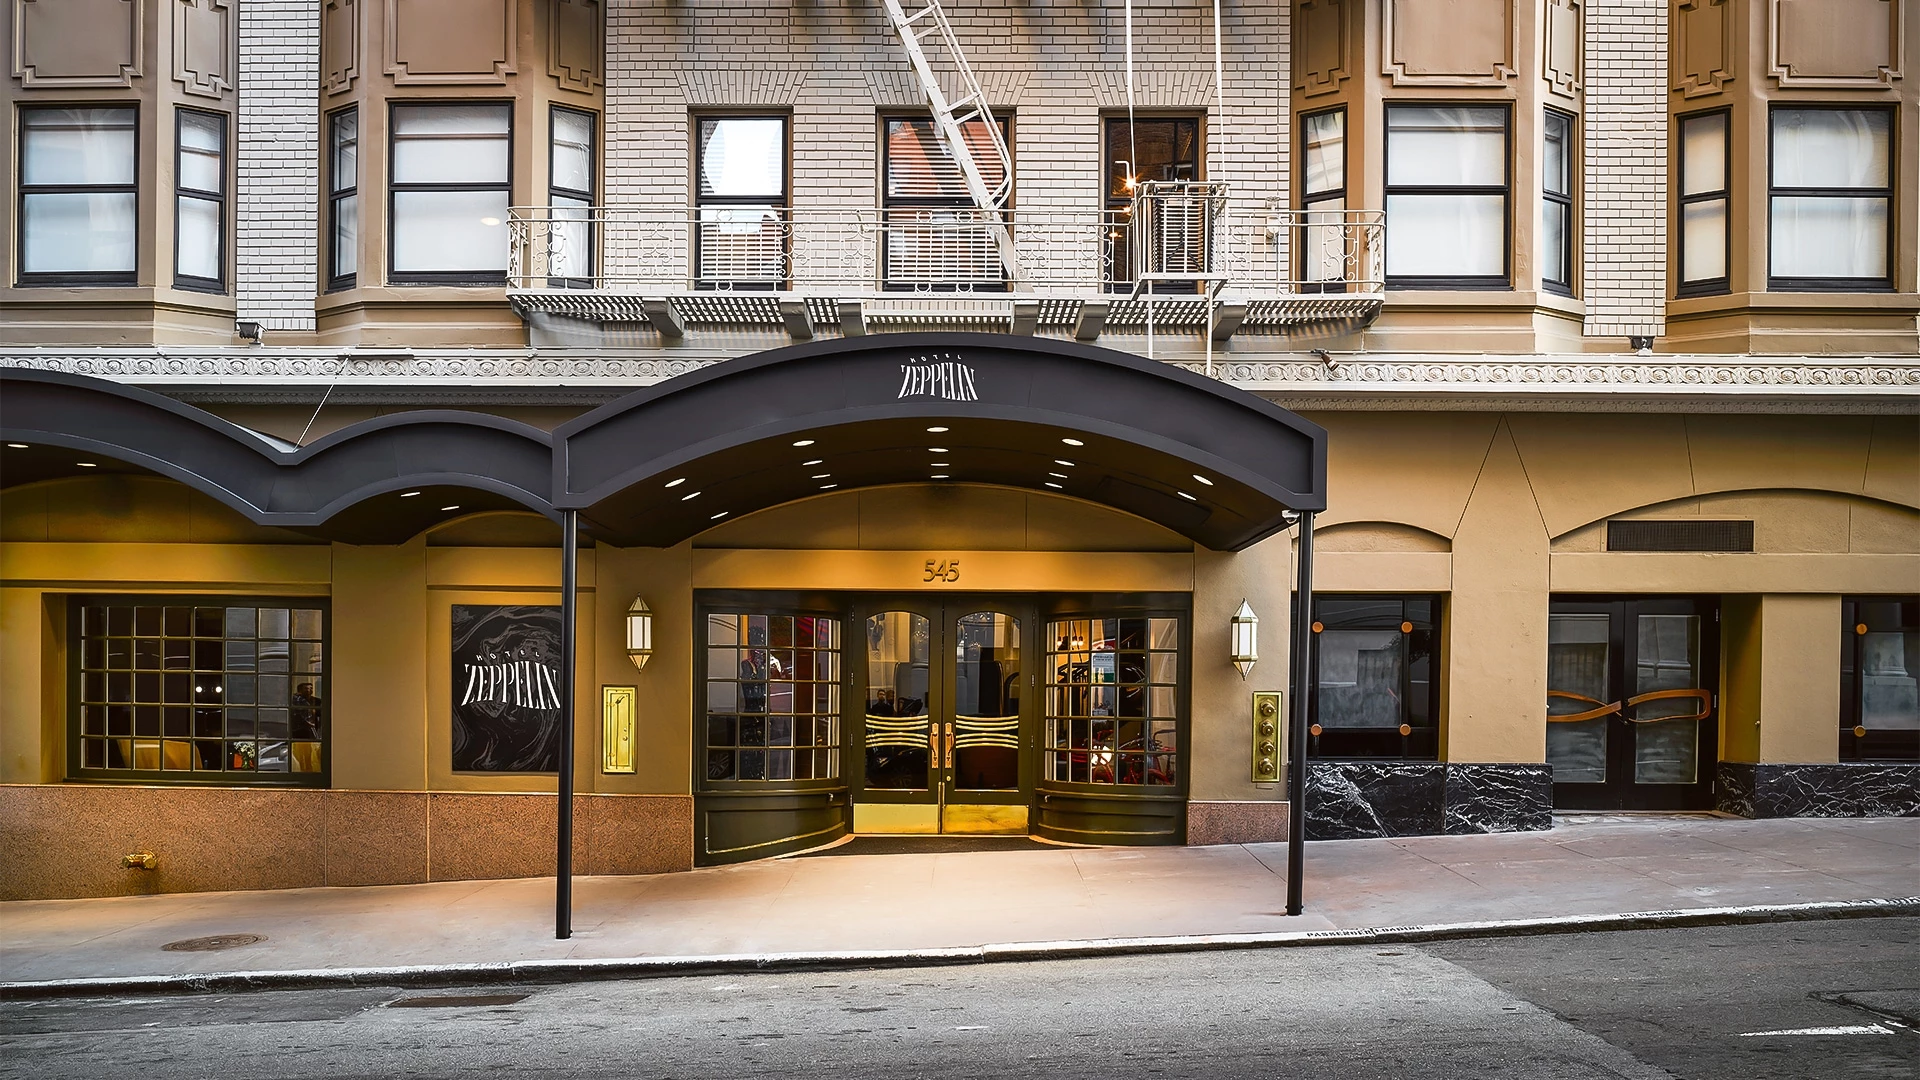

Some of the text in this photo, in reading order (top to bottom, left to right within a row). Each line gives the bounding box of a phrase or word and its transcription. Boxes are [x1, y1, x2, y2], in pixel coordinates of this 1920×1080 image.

[909, 353, 962, 363] HOTEL
[897, 362, 979, 401] ZEPPELIN
[923, 559, 960, 582] 545
[476, 650, 540, 661] HOTEL
[461, 660, 561, 710] ZEPPELIN
